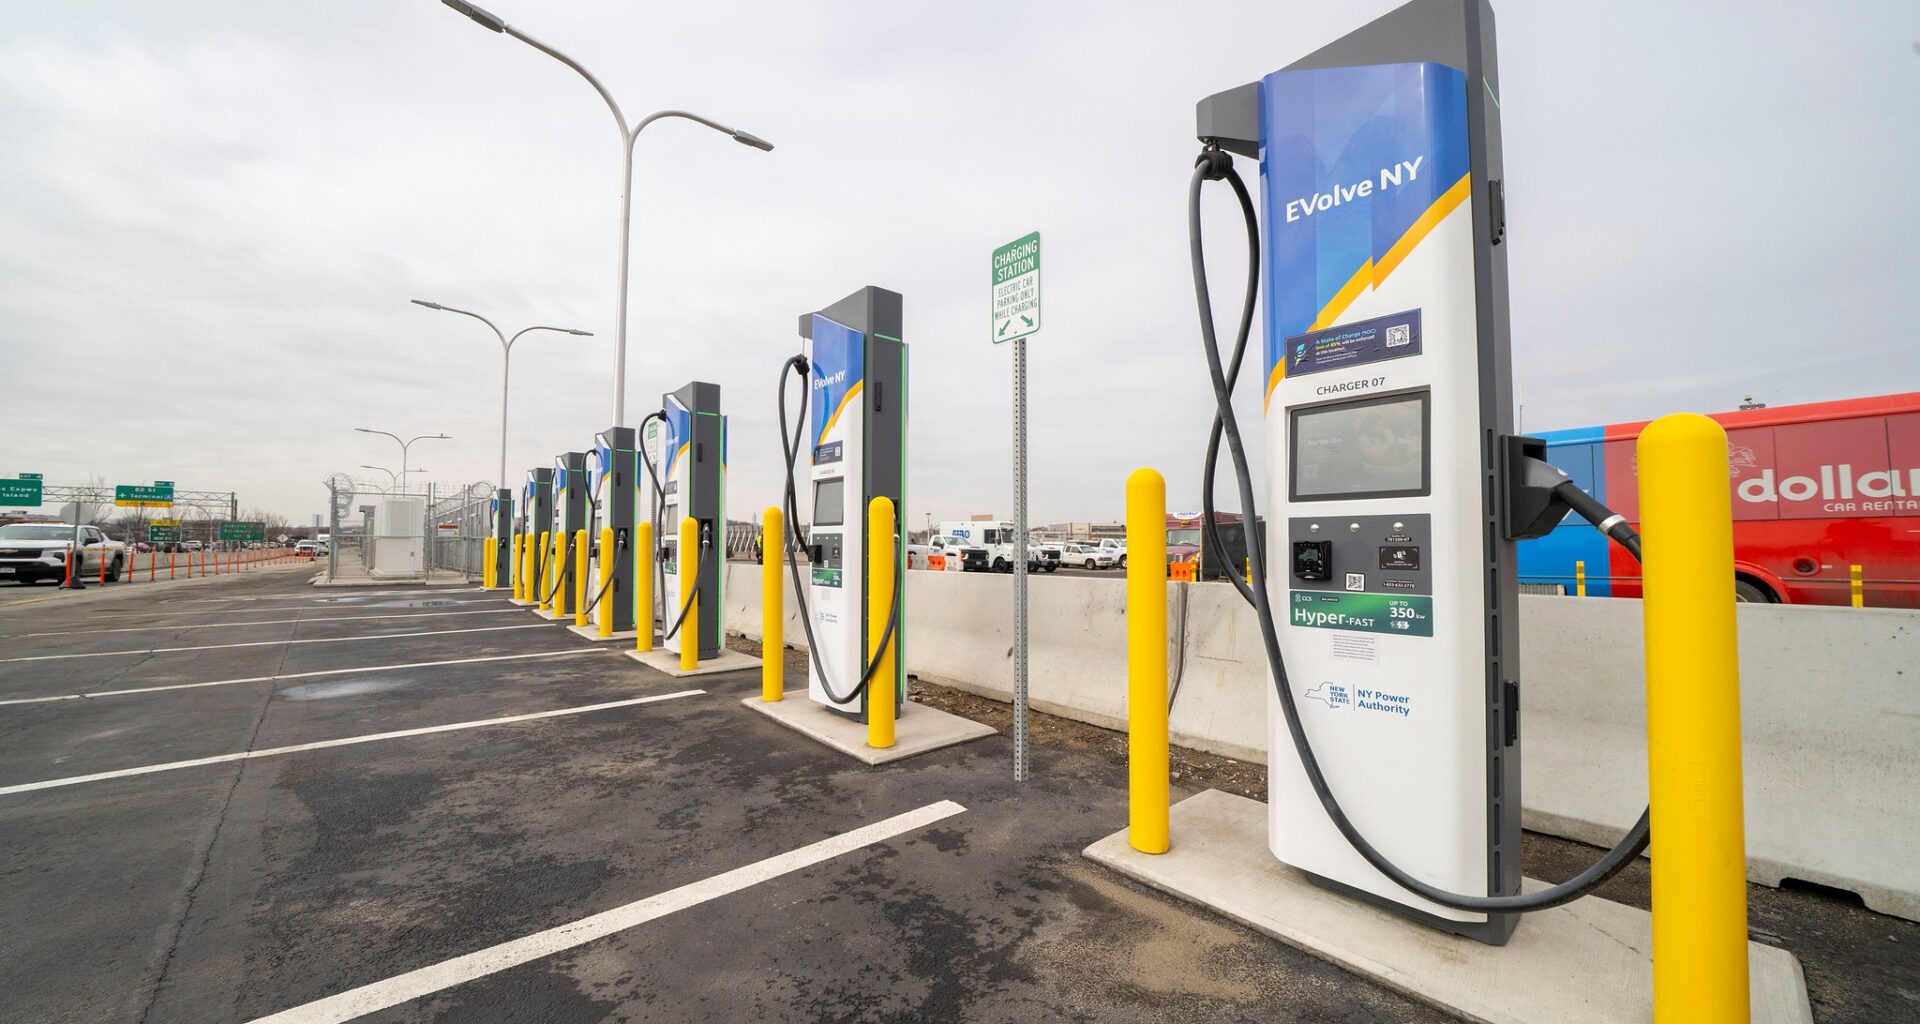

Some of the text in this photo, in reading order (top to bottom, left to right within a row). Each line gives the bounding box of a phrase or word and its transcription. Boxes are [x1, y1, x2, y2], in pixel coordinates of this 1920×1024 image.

[1286, 156, 1424, 223] EVolve NY
[994, 240, 1037, 268] CHARGING
[997, 256, 1034, 281] STATION
[998, 276, 1033, 298] ELECTRIC CAR
[997, 287, 1034, 309] PARKING ONLY
[995, 298, 1038, 320] WHILE CHARGING
[814, 370, 846, 390] EVolve NY
[1316, 376, 1386, 396] CHARGER 07
[1824, 500, 1920, 513] CAR RENTA
[1389, 607, 1415, 619] 350
[1329, 685, 1345, 693] NEW
[1330, 691, 1348, 699] YORK
[1357, 689, 1410, 704] NY Power
[1357, 700, 1410, 717] Authority
